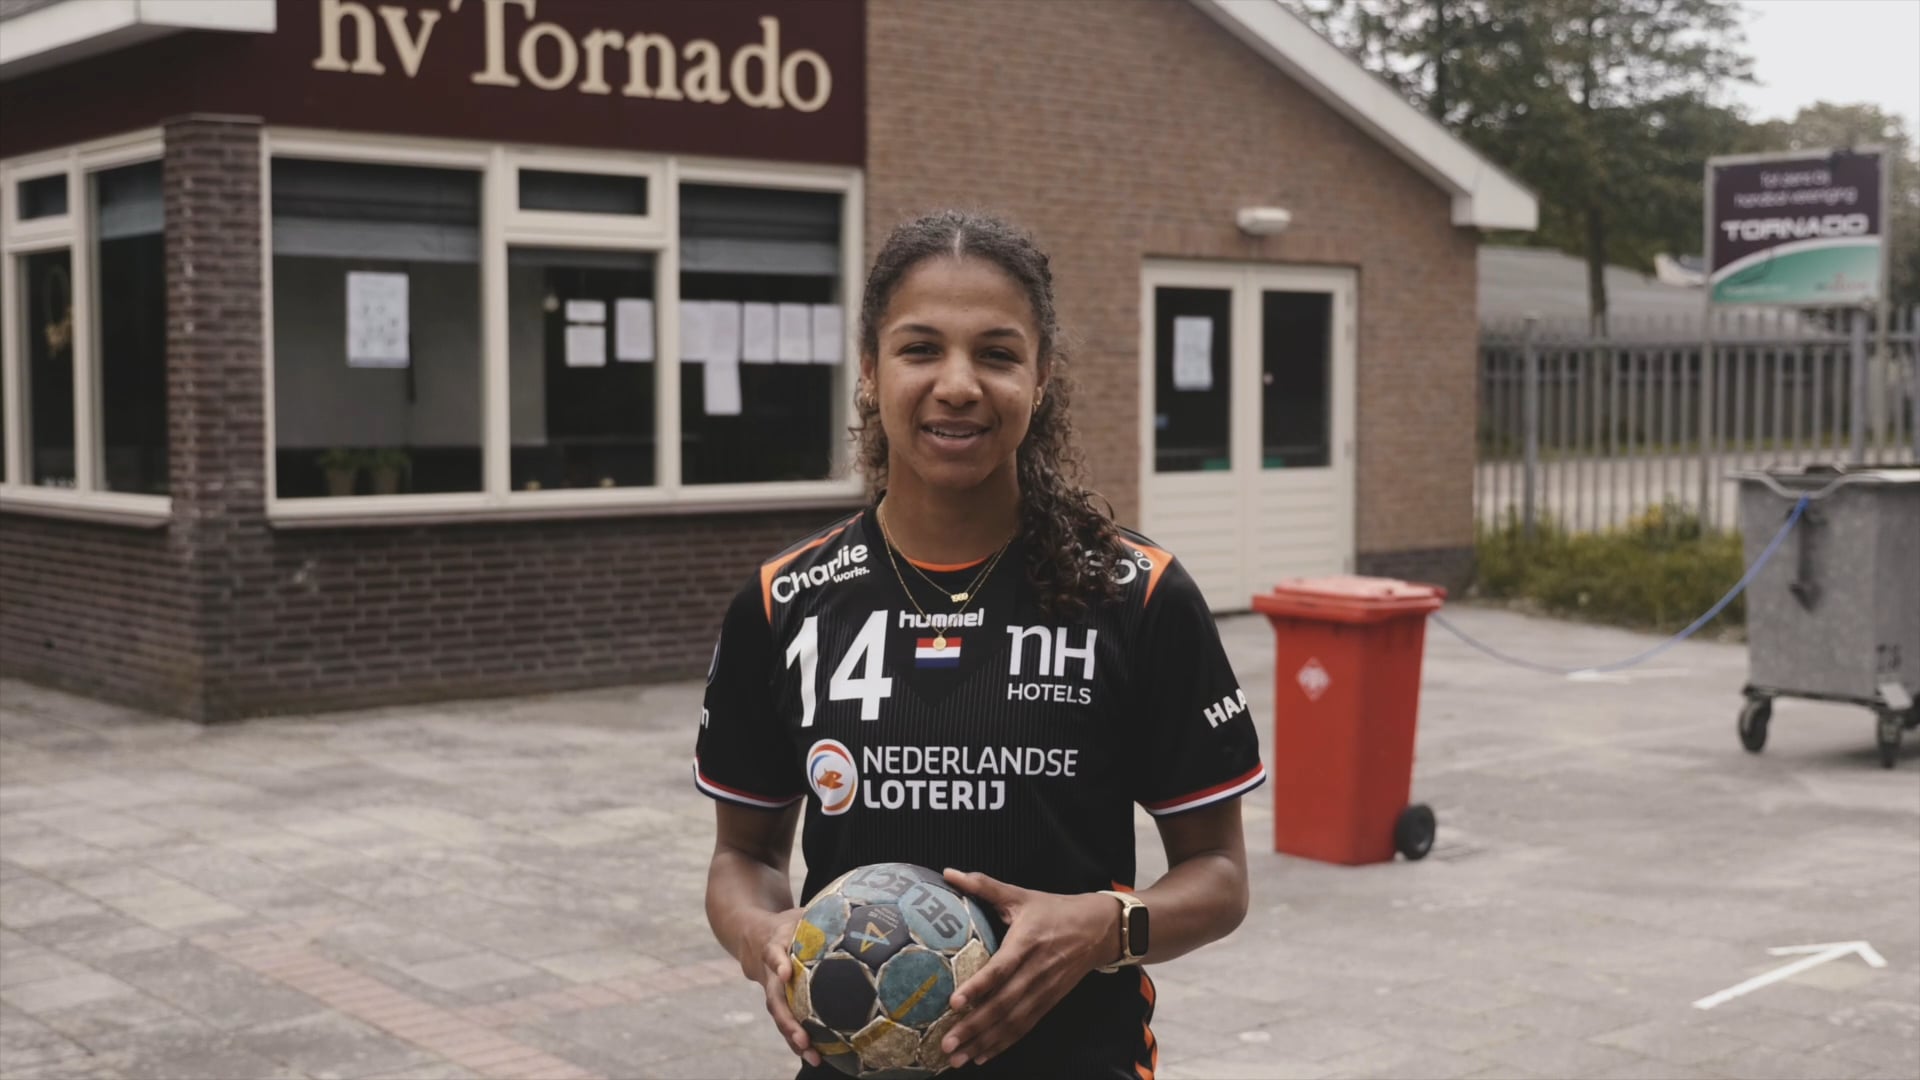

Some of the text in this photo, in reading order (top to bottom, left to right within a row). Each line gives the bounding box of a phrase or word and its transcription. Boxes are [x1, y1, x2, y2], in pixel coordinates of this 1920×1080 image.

[312, 0, 832, 112] hv Tornado
[1721, 213, 1869, 241] TORNADO
[771, 544, 869, 603] Charlie
[833, 566, 871, 583] works.
[898, 607, 985, 629] hummel
[785, 610, 893, 728] 14
[1007, 683, 1092, 705] HOTELS
[862, 745, 1079, 777] NEDERLANDSE
[863, 780, 1006, 811] LOTERIJ
[851, 869, 963, 939] SELECT
